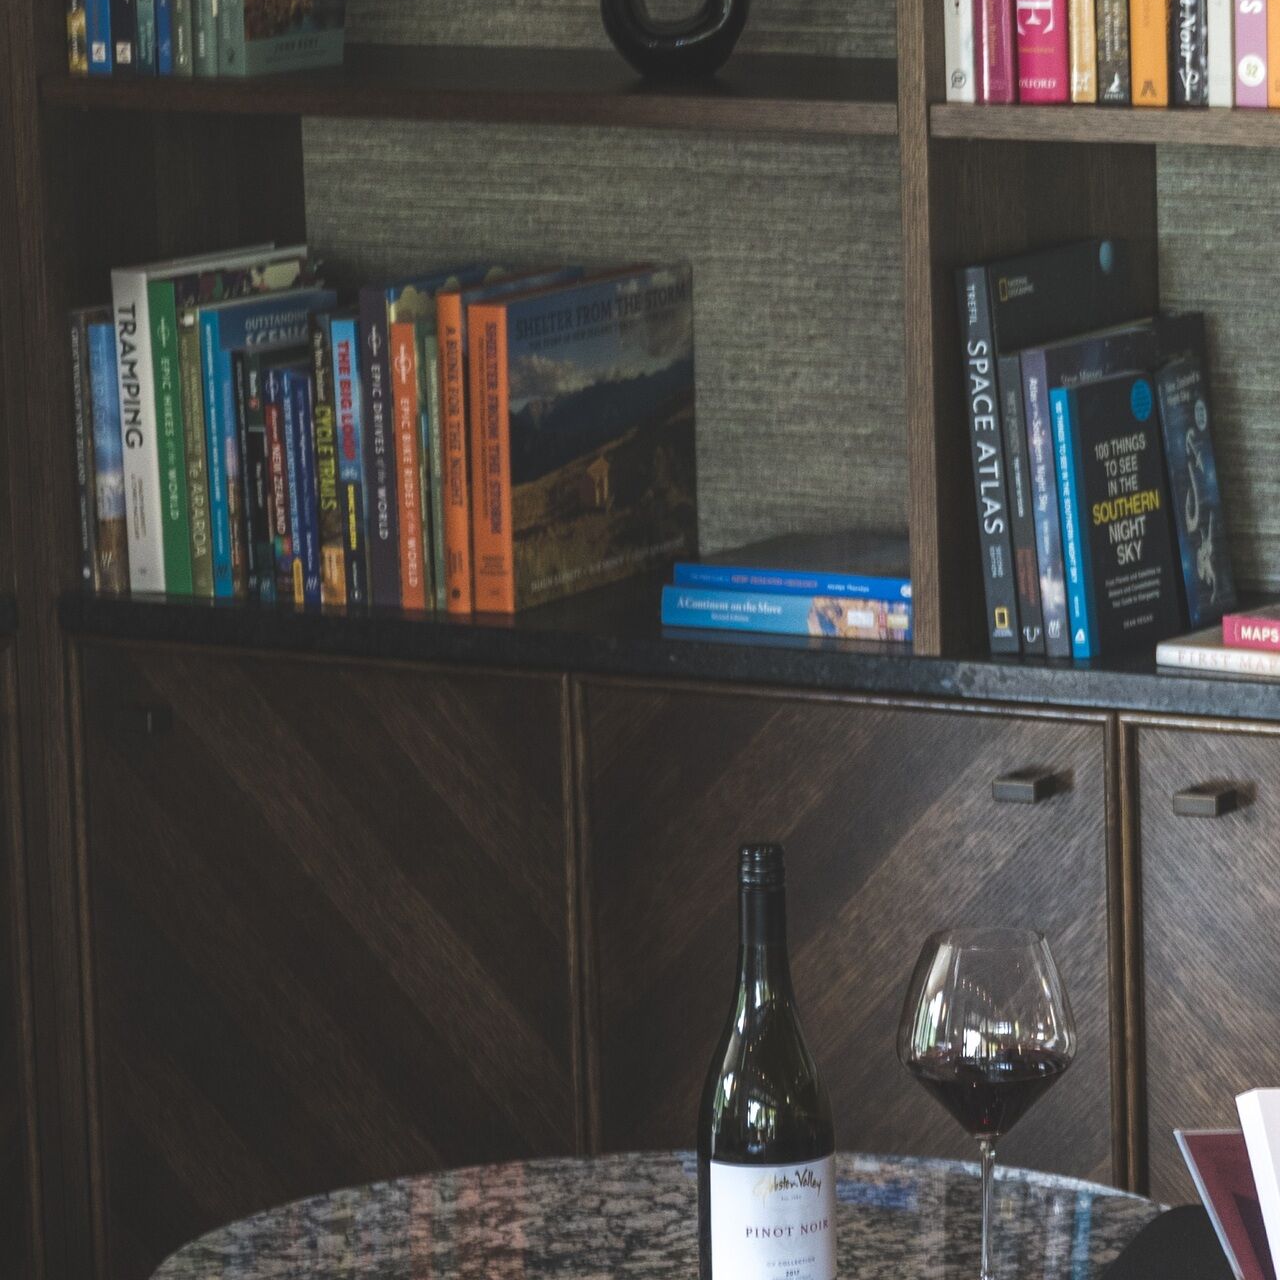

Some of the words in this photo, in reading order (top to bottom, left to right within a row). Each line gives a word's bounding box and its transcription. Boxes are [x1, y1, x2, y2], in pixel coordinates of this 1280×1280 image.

[516, 305, 574, 340] SHELTER
[574, 298, 612, 326] FROM
[614, 293, 642, 314] THE
[116, 303, 145, 450] TRAMPING
[966, 338, 995, 432] SPACE
[400, 397, 411, 428] EPIC
[401, 432, 413, 466] BIKE
[1094, 442, 1110, 461] 100
[1109, 432, 1146, 458] THINGS
[1105, 458, 1118, 475] TO
[1118, 454, 1138, 473] SEE
[403, 467, 415, 508] RIDES
[976, 441, 1005, 537] ATLAS
[1107, 478, 1119, 497] IN
[1118, 474, 1138, 494] THE
[1092, 489, 1160, 525] SOUTHERN
[1108, 515, 1146, 545] NIGHT
[407, 536, 418, 589] WORLD
[1116, 540, 1143, 566] SKY
[795, 1167, 822, 1197] Valley
[745, 1226, 794, 1238] PINOT
[800, 1219, 829, 1235] NOIR
